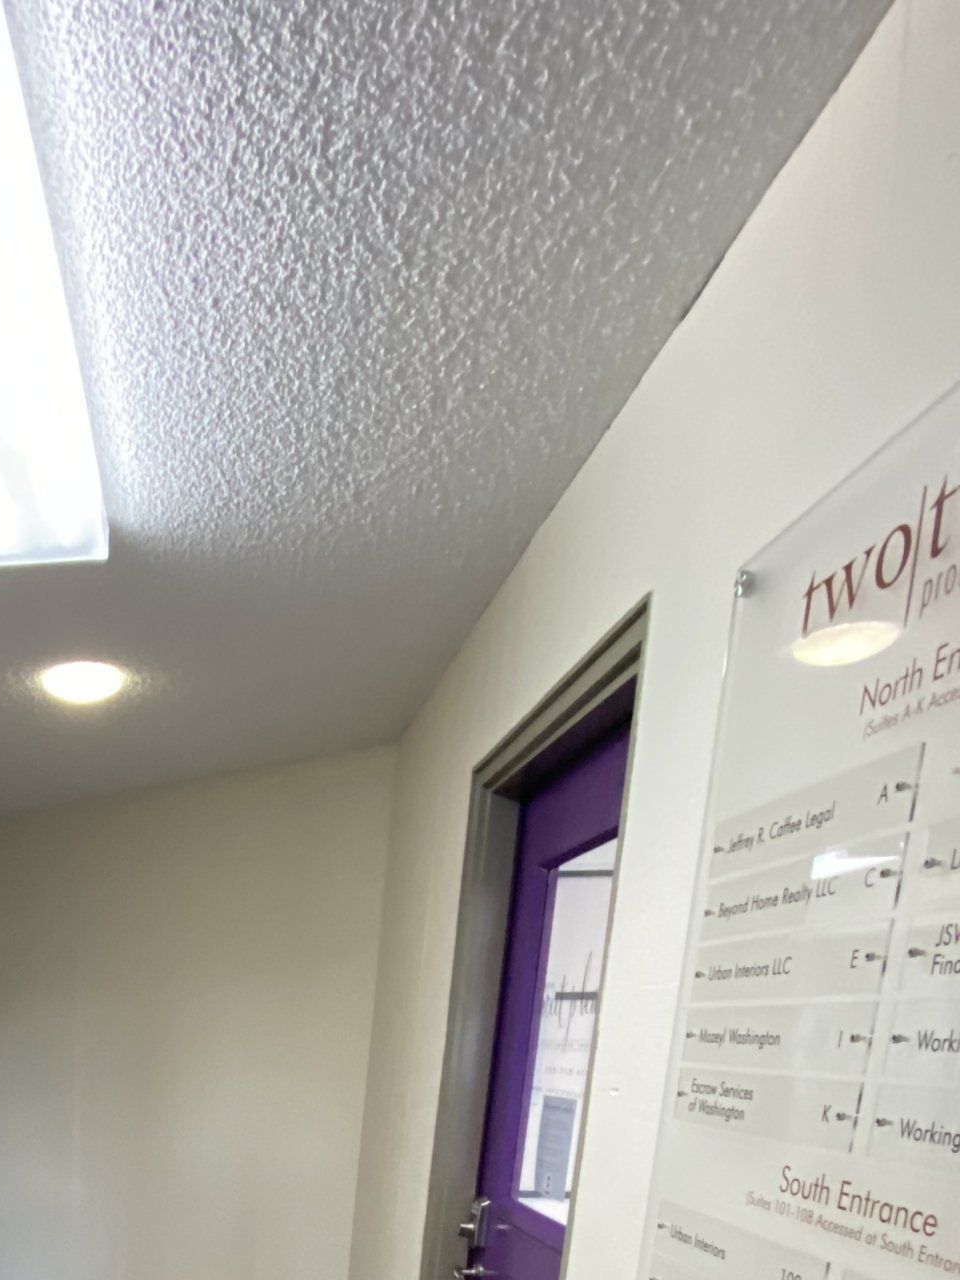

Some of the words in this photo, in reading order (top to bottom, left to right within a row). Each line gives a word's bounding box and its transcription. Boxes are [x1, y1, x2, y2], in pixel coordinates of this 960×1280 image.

[919, 563, 960, 620] pro
[859, 656, 923, 717] North
[877, 783, 889, 805] A
[727, 832, 754, 854] Jeffrey
[805, 800, 836, 829] Legal
[951, 848, 960, 870] L
[864, 867, 876, 888] C
[718, 897, 749, 919] Beyond
[750, 894, 779, 912] Home
[782, 882, 813, 905] Realty
[816, 876, 838, 898] LLC
[708, 965, 732, 981] Urban
[734, 963, 770, 980] Interiors
[772, 956, 793, 975] LLC
[850, 949, 859, 969] E
[728, 1027, 781, 1050] Washington
[719, 1080, 754, 1101] Services
[688, 1097, 698, 1113] of
[699, 1099, 745, 1122] Washington
[821, 1104, 832, 1123] K
[900, 1117, 960, 1154] Working
[779, 1164, 830, 1206] South
[836, 1180, 938, 1237] Entrance
[670, 1223, 692, 1246] Urban
[693, 1233, 726, 1260] Interiors
[774, 1199, 814, 1225] 101-108
[814, 1213, 864, 1242] Accessed
[864, 1232, 878, 1247] at
[879, 1232, 914, 1260] South
